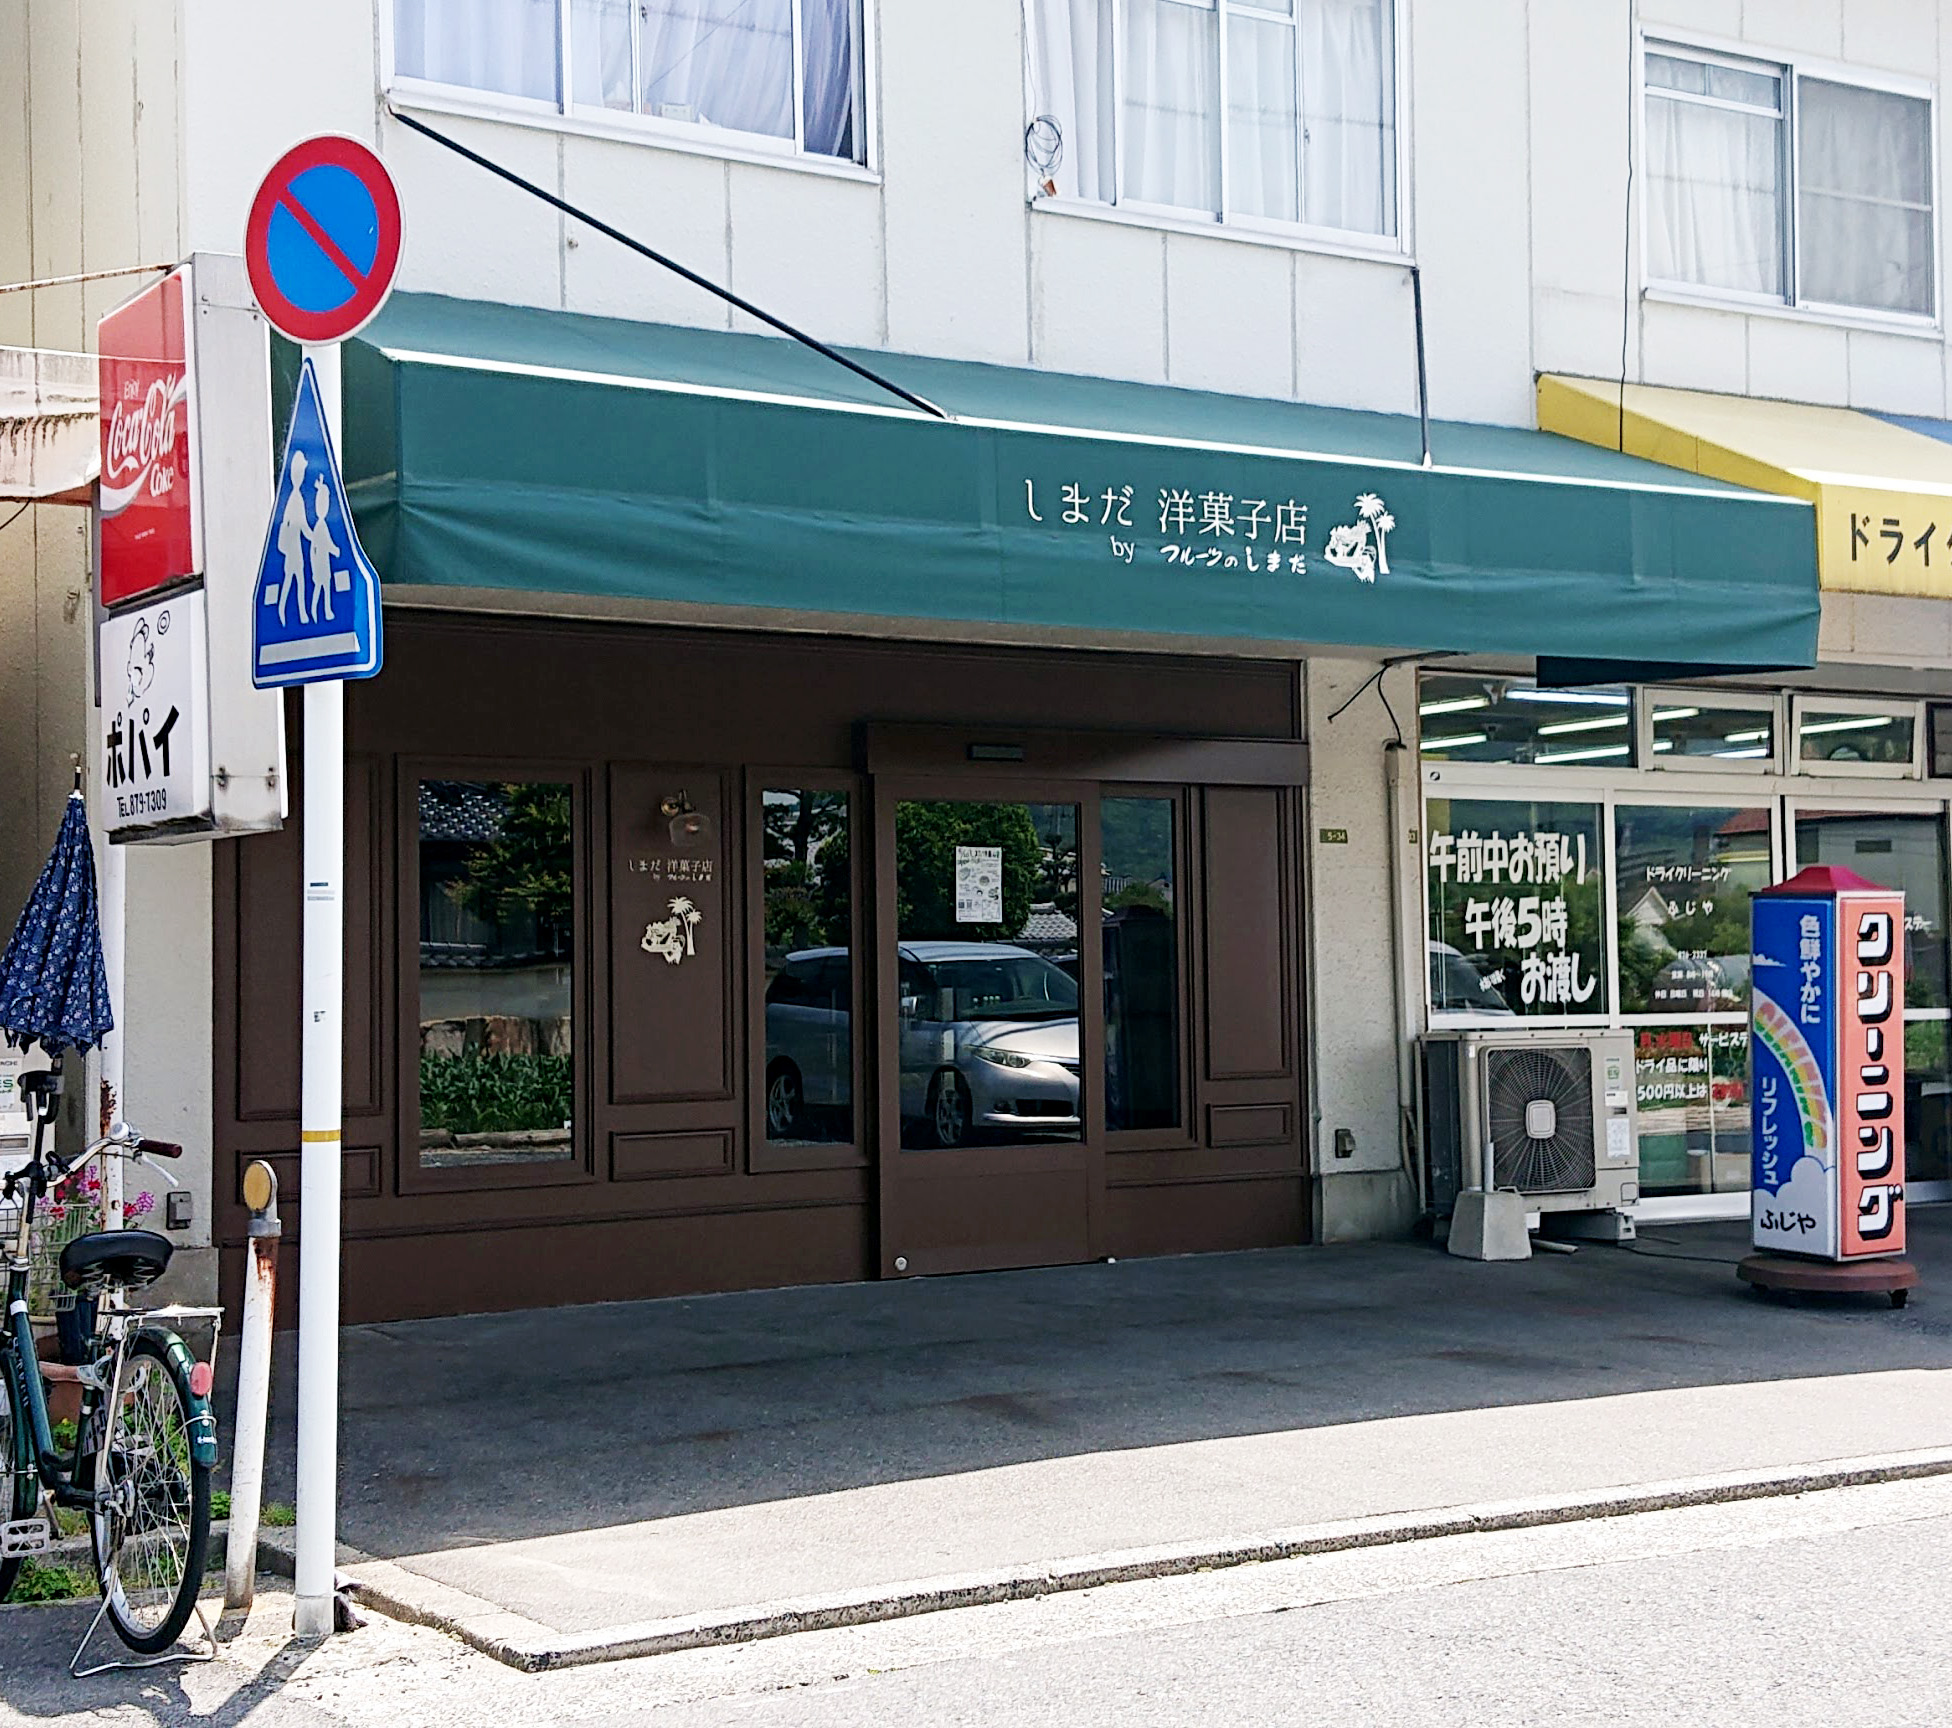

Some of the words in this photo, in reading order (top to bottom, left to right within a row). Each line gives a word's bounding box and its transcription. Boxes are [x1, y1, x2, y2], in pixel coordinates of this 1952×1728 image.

[107, 370, 177, 479] Coca-Cola
[150, 462, 175, 497] Coke
[1024, 478, 1135, 527] しまだ
[1157, 487, 1309, 545] 洋菓子店
[1110, 535, 1136, 564] by
[1850, 512, 1952, 568] ドライ
[106, 704, 180, 789] ポパイ
[628, 859, 661, 872] しまだ
[667, 858, 713, 873] 洋菓子店
[1429, 829, 1586, 885] 午前中お預り
[1646, 865, 1732, 882] ドライクリーニング
[1464, 895, 1568, 950] 午後5時
[1667, 900, 1714, 916] ふじや
[1520, 951, 1598, 1005] お渡し
[1799, 914, 1822, 1025] 色鮮やかに
[1635, 1056, 1709, 1074] ドライ品に限り
[1636, 1082, 1708, 1102] 500円以上は
[1856, 912, 1904, 1241] クリーニング
[1761, 1076, 1779, 1186] リフレッシュ
[1760, 1209, 1817, 1234] ふじや
